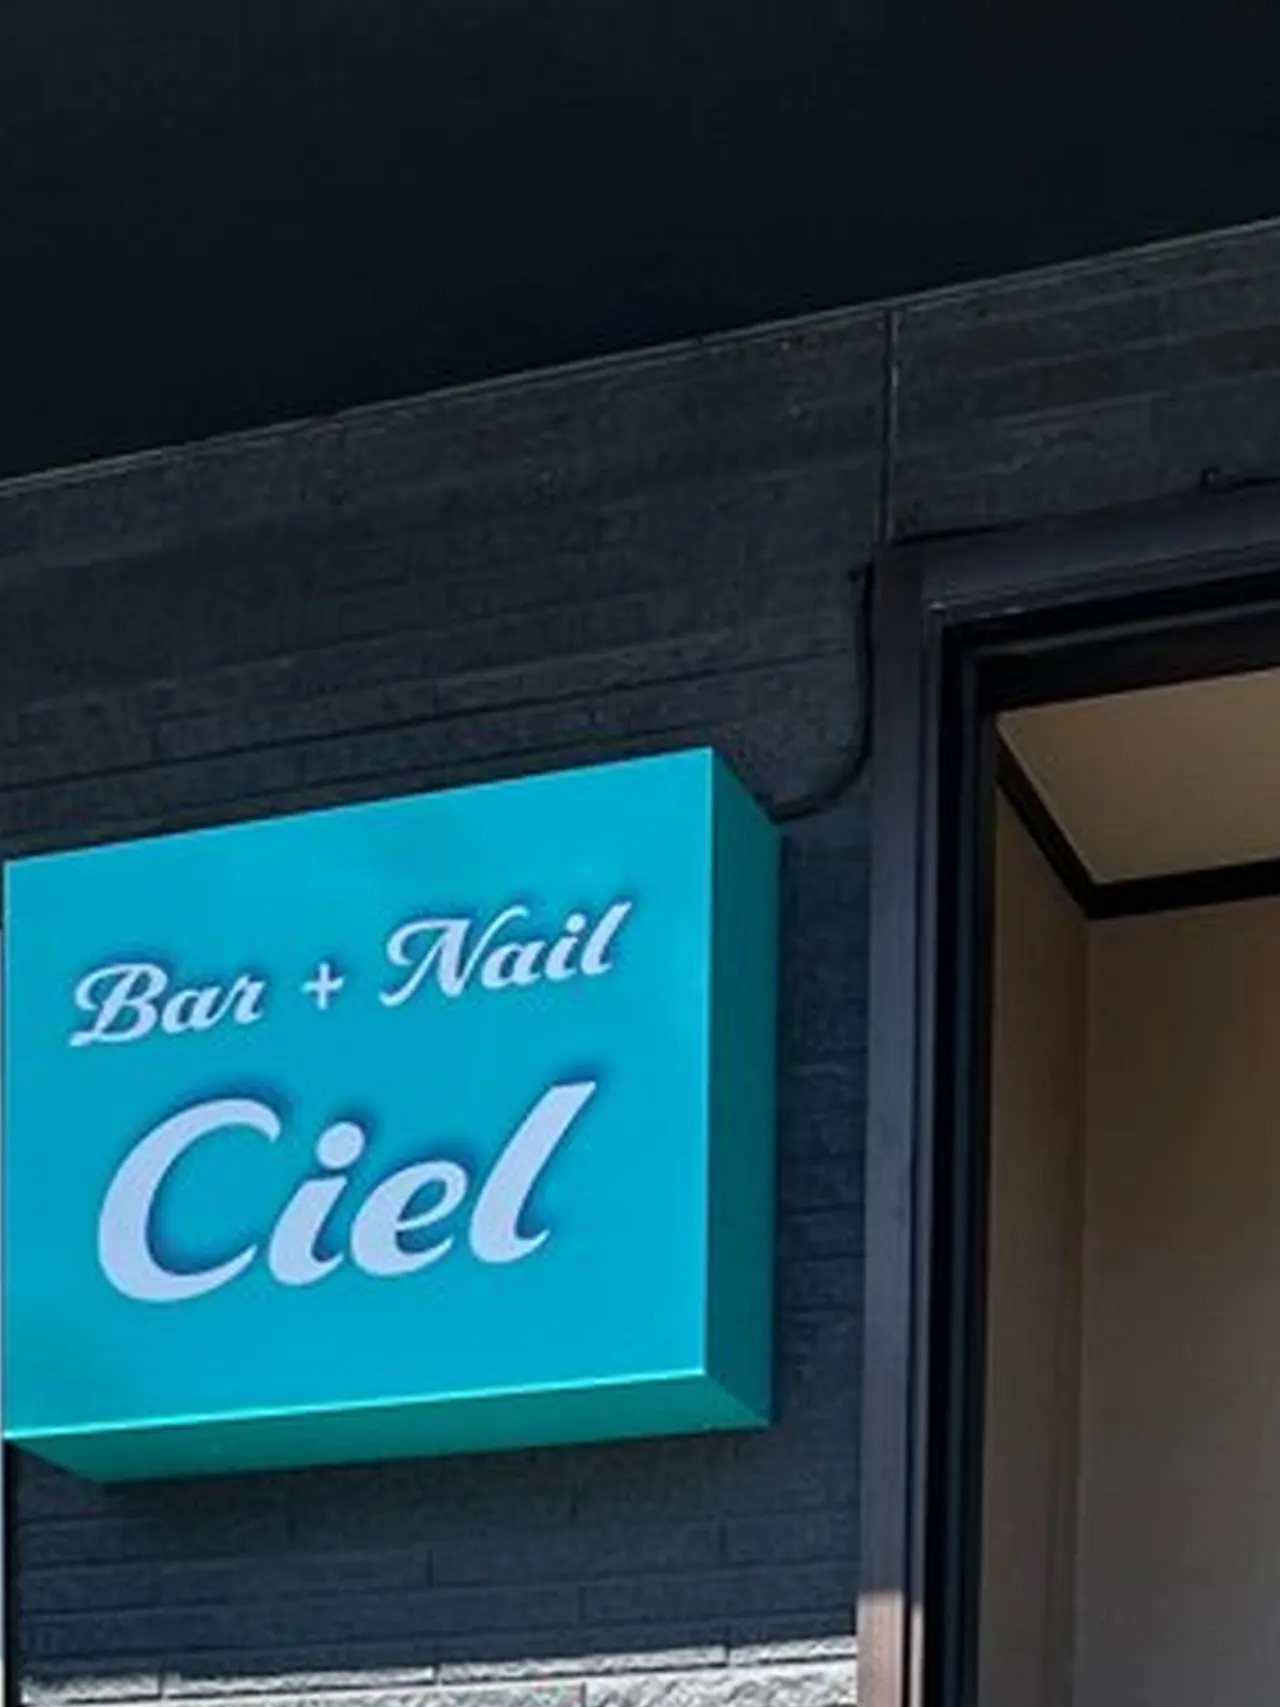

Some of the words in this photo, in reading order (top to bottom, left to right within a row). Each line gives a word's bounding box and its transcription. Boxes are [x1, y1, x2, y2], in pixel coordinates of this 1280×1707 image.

[68, 963, 266, 1048] Bar
[302, 962, 344, 1010] +
[377, 901, 634, 1008] Nail
[97, 1081, 598, 1303] Ciel
